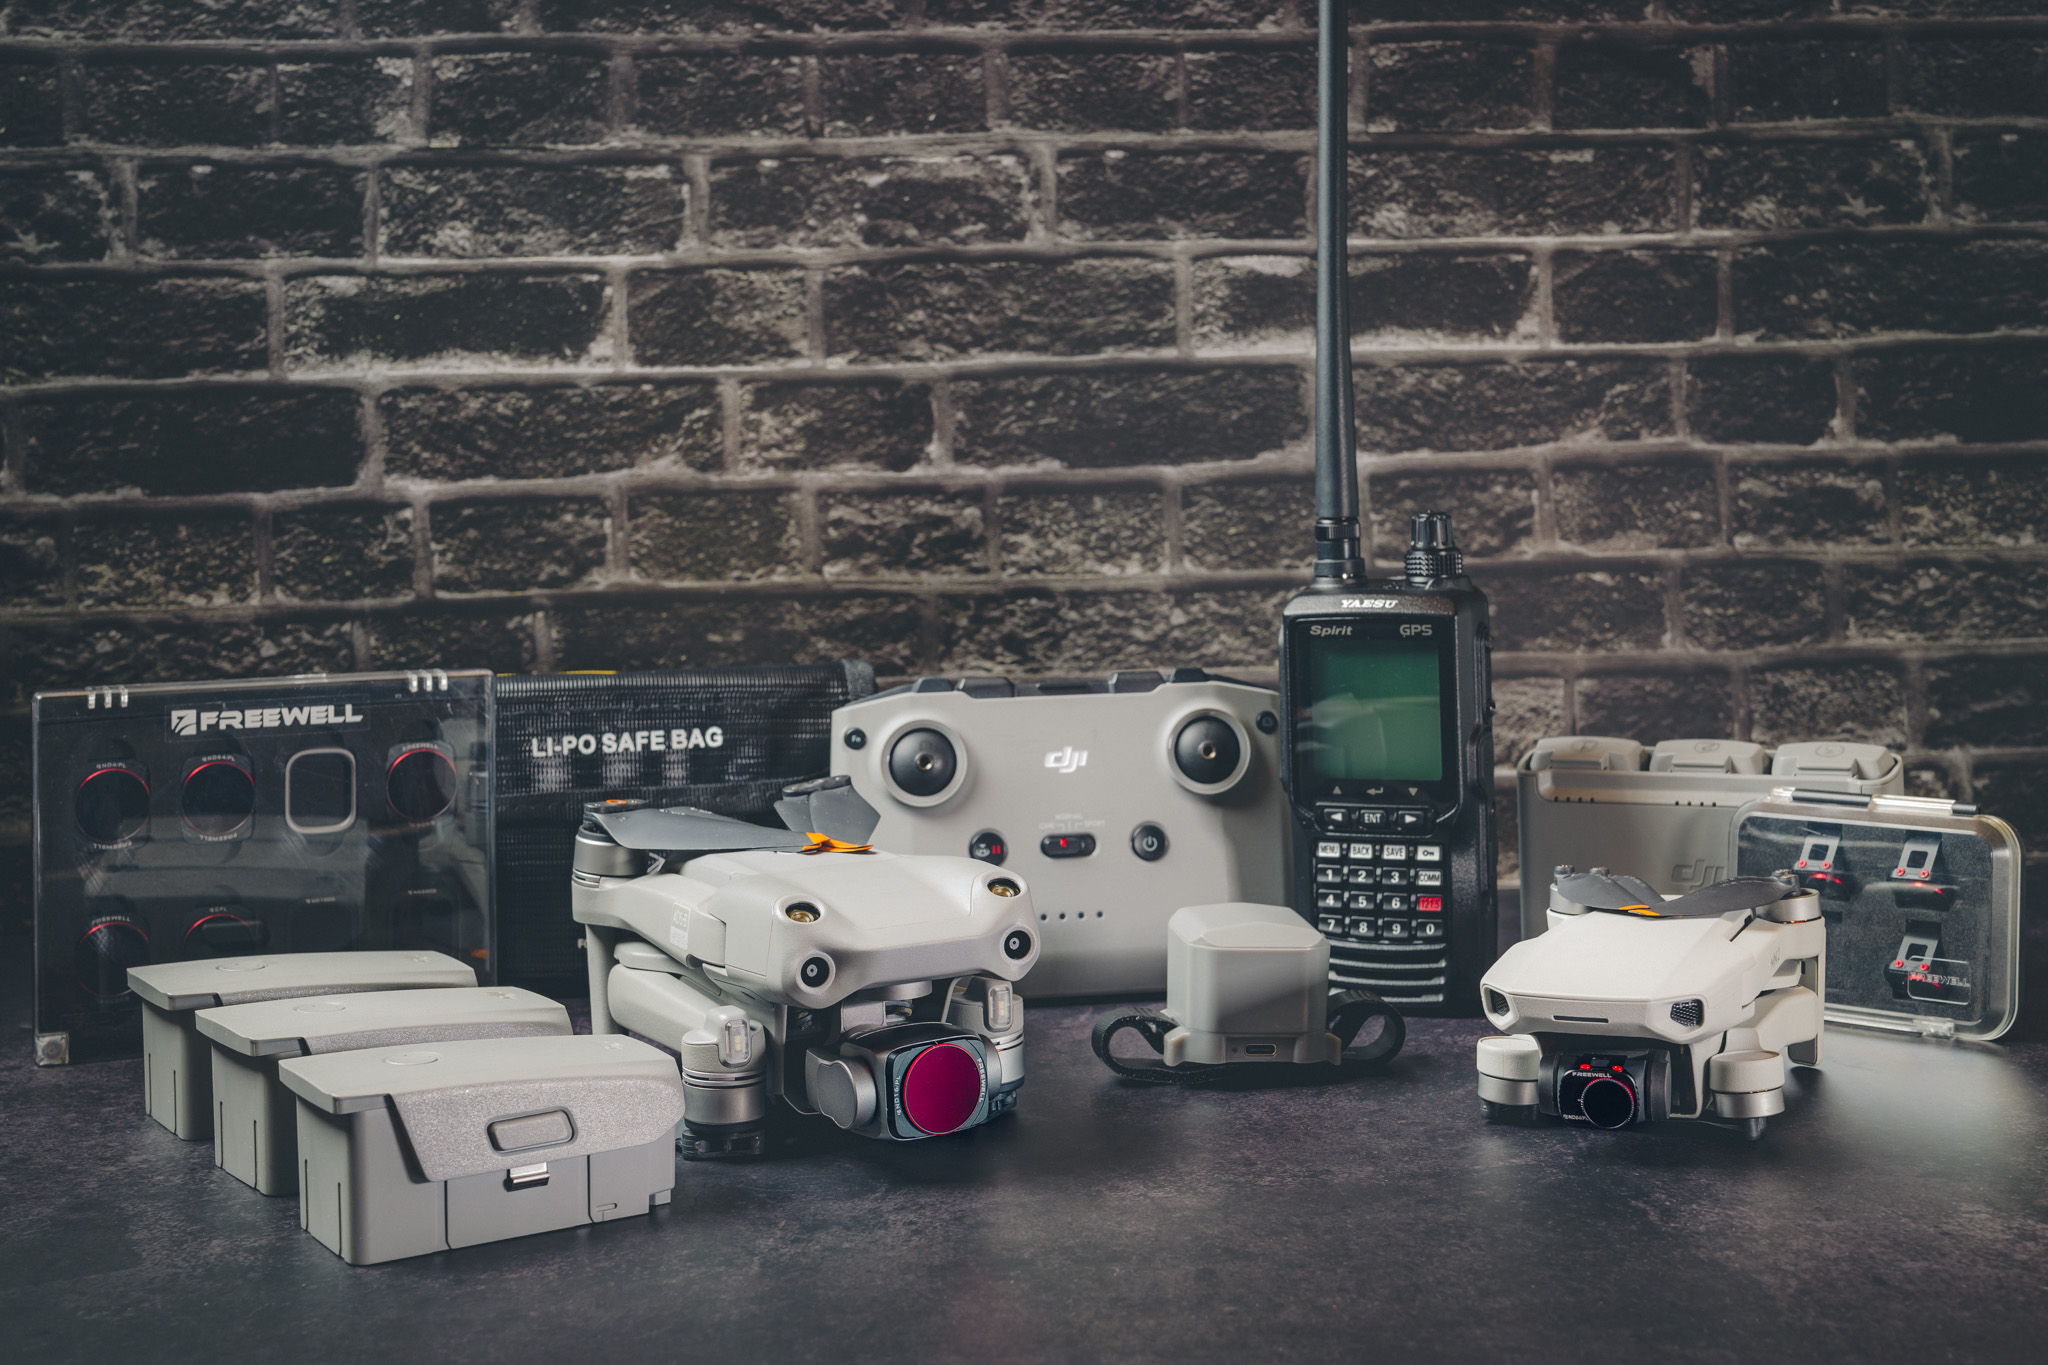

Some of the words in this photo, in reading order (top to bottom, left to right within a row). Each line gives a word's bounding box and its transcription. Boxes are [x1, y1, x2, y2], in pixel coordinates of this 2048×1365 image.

[1340, 599, 1399, 609] YAESU
[1309, 624, 1353, 638] Spirit
[1399, 624, 1433, 637] GPS
[199, 702, 363, 732] FREEWELL
[531, 733, 597, 758] LI-PO
[601, 729, 666, 754] SAFE
[670, 725, 724, 750] BAG
[851, 734, 862, 744] Fn
[1364, 812, 1382, 824] ENT
[1320, 844, 1339, 855] MENU
[1352, 846, 1370, 856] BACK
[1385, 847, 1404, 857] SAVE
[1325, 869, 1333, 880] 1
[1357, 870, 1367, 881] 2
[1390, 872, 1400, 883] 3
[1419, 873, 1441, 884] COMM
[1325, 894, 1335, 906] 4
[1358, 895, 1367, 907] 5
[1391, 897, 1401, 908] 6
[1420, 898, 1440, 910] 121.5
[1326, 919, 1336, 931] 7
[1358, 921, 1368, 933] 8
[1391, 923, 1401, 935] 9
[1425, 923, 1435, 935] 0
[976, 1057, 987, 1103] FREEWELL
